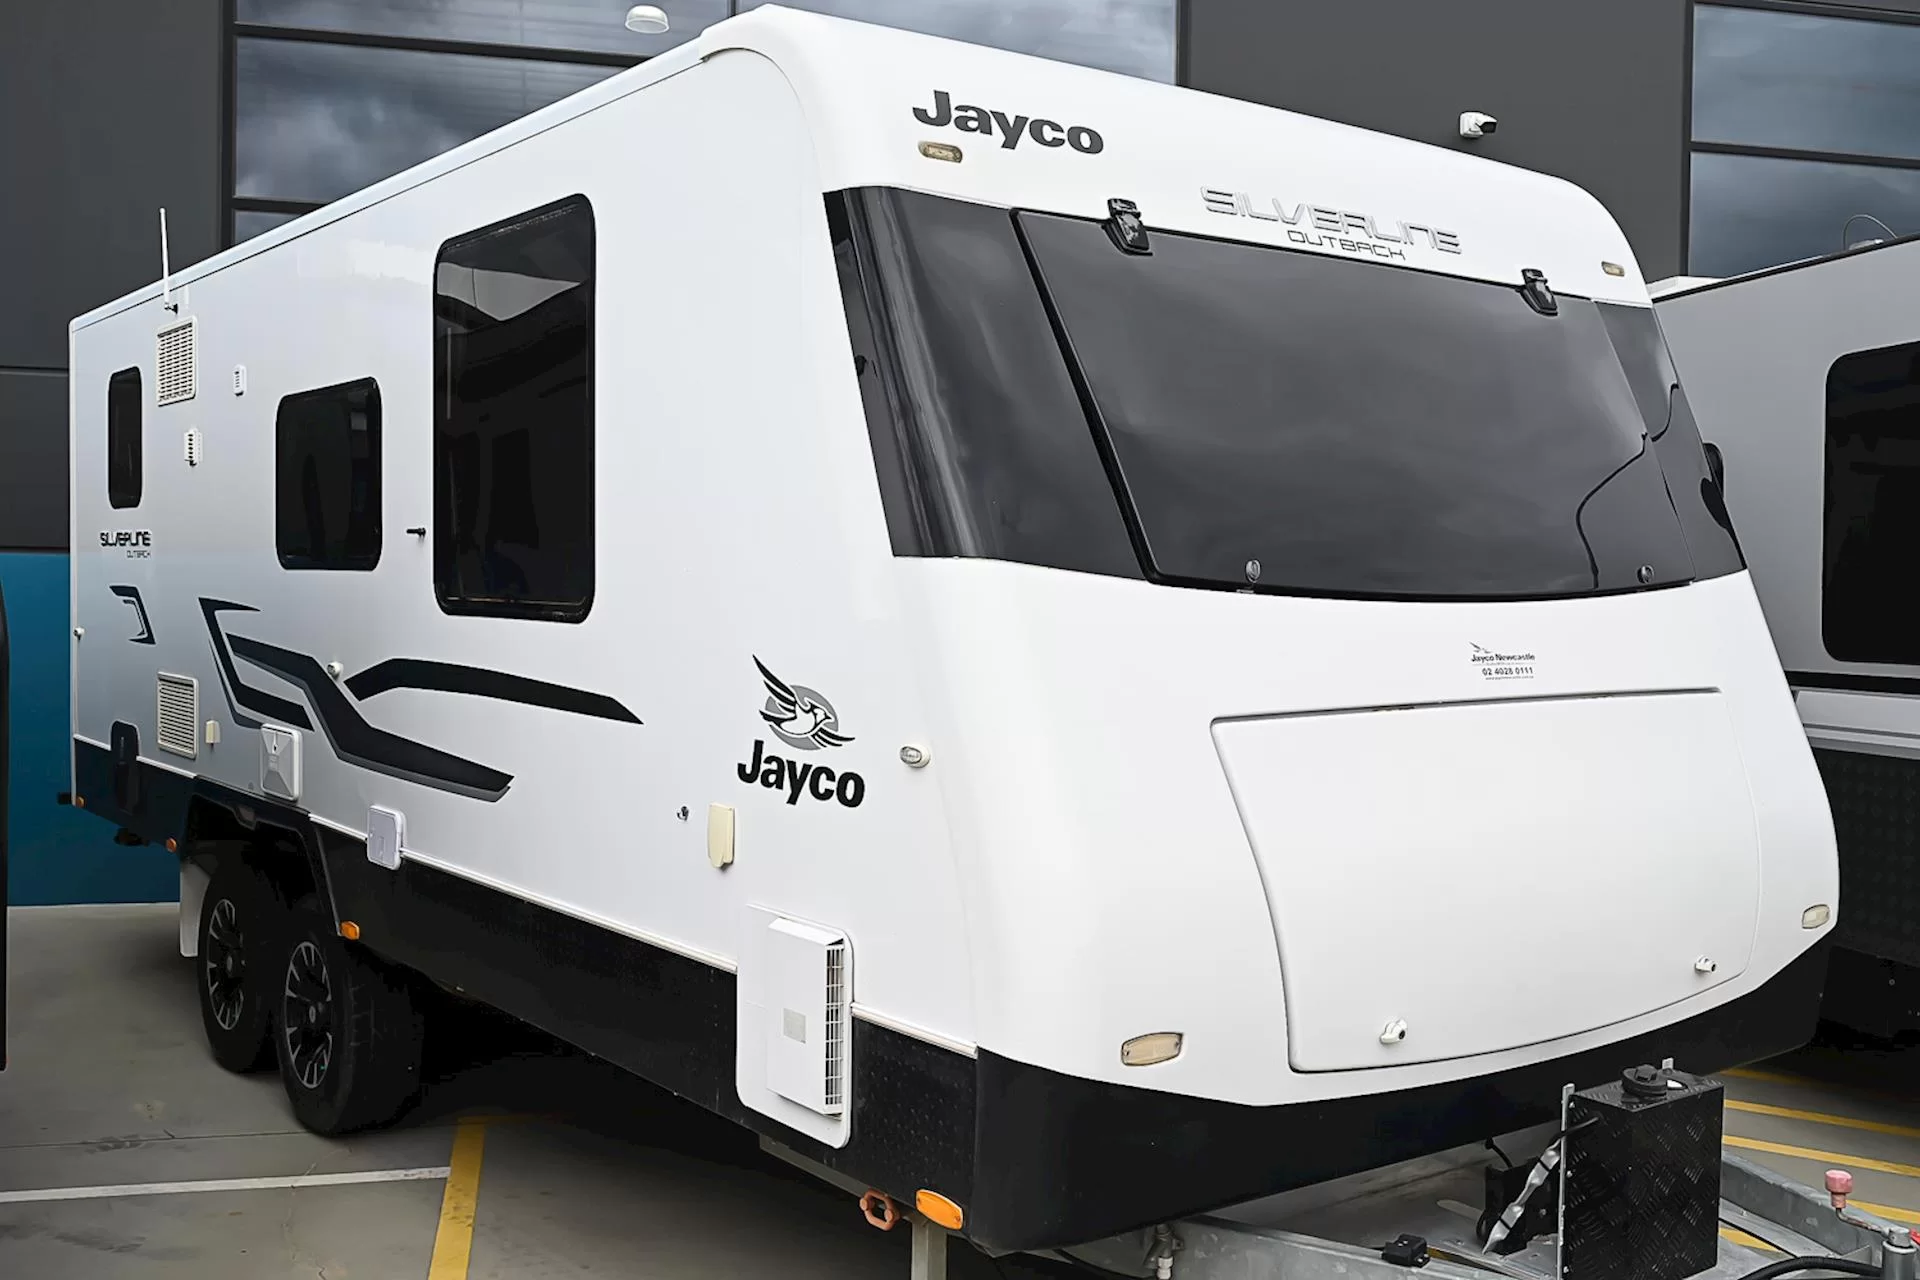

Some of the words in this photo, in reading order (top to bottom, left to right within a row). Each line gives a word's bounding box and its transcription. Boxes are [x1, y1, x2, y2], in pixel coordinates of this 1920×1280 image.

[912, 89, 1104, 155] Jayco
[1200, 186, 1462, 255] SILVERLINE
[1287, 230, 1406, 260] OUTBACK
[1471, 654, 1494, 663] Jayco
[1495, 653, 1535, 661] Newcastle
[1482, 667, 1492, 676] 02
[1494, 667, 1513, 675] 4028
[737, 739, 865, 808] Jayco
